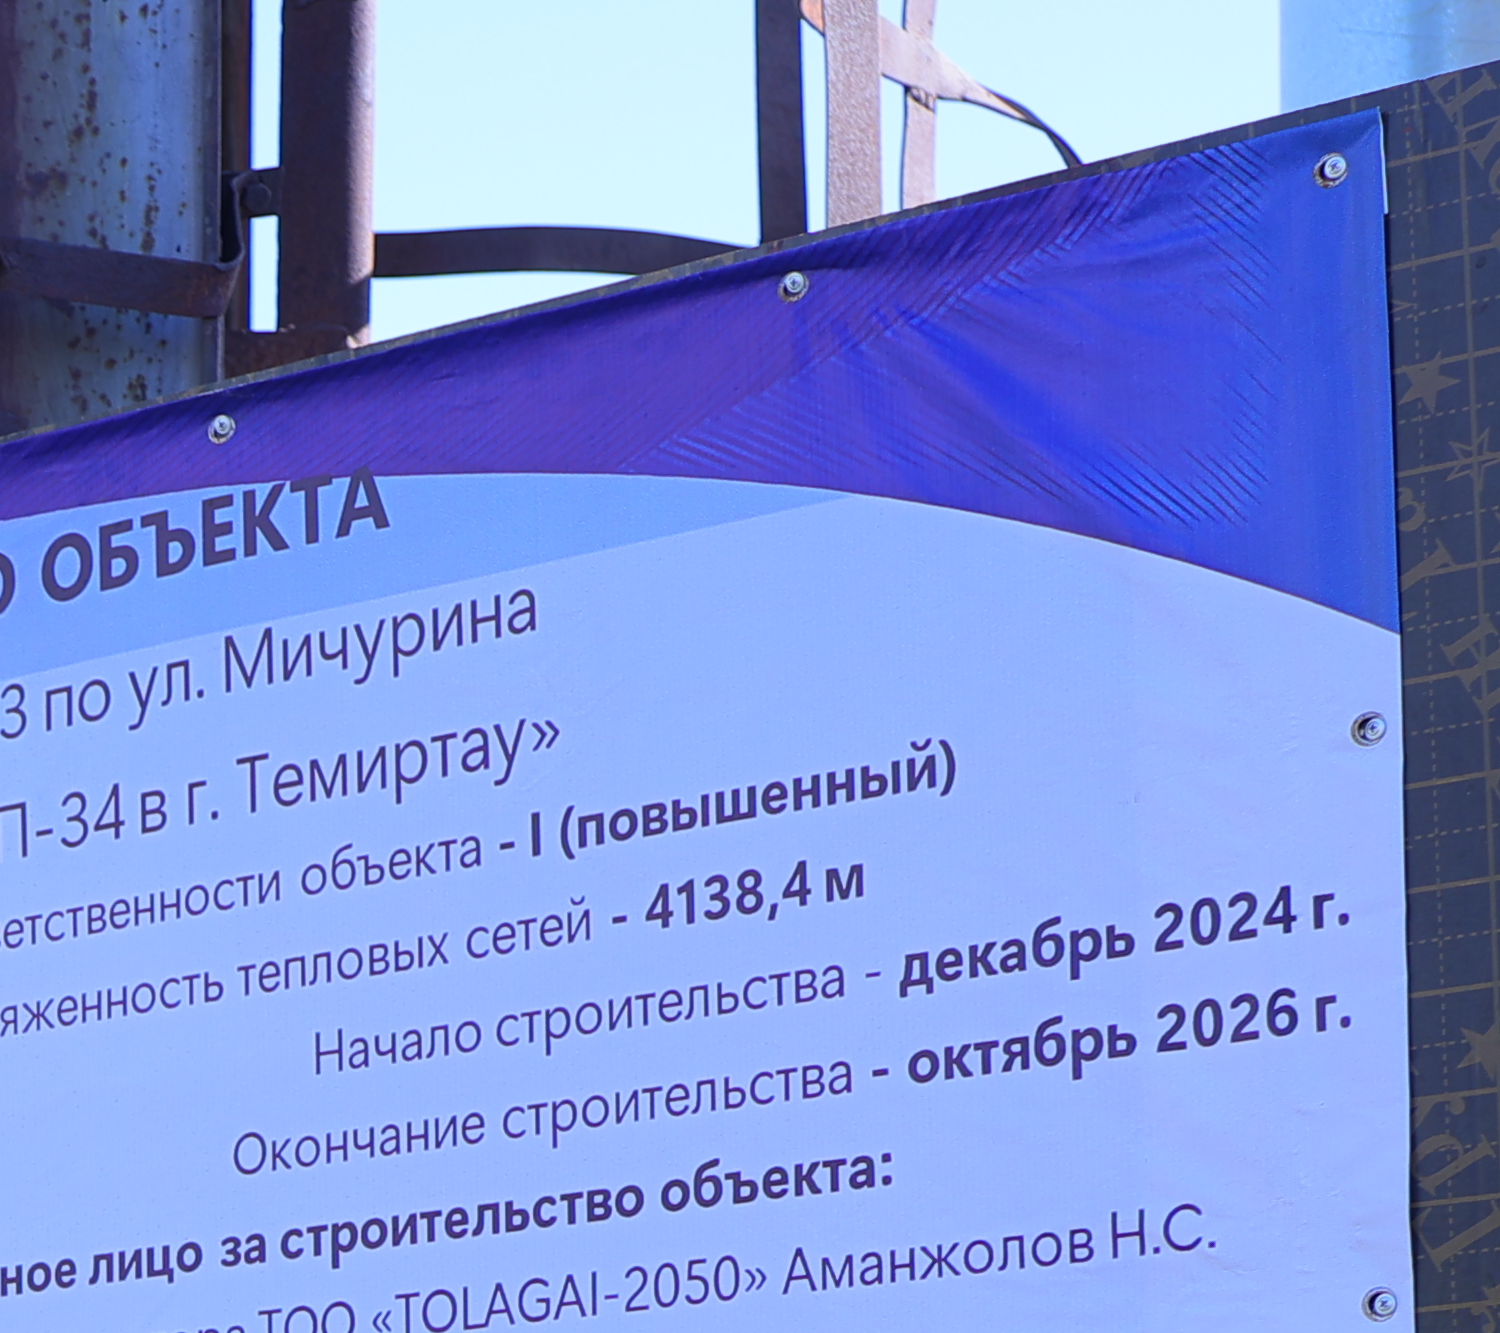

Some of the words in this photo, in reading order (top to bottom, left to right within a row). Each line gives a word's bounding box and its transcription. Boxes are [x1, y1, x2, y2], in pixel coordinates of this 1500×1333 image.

[41, 464, 392, 605] ОБЪЕКТА
[45, 679, 111, 731] по
[129, 659, 204, 731] ул.
[224, 588, 536, 693] Мичурина
[140, 790, 167, 834] в
[188, 780, 219, 825] г.
[236, 719, 560, 813] Темиртау»
[301, 836, 481, 895] объекта
[531, 811, 541, 857] I
[560, 738, 956, 860] (повышенный)
[237, 932, 448, 996] тепловых
[466, 895, 591, 959] сетей
[645, 860, 812, 928] 4138,4
[825, 864, 864, 902] м
[315, 1021, 482, 1075] Начало
[496, 965, 845, 1056] строительства
[899, 915, 1135, 998] декабрь
[1154, 885, 1298, 952] 2024
[1312, 893, 1350, 929] г.
[233, 1112, 485, 1175] Окончание
[503, 1060, 852, 1148] строительства
[908, 1015, 1137, 1084] октябрь
[1157, 987, 1299, 1053] 2026
[1315, 995, 1351, 1032] г.
[89, 1241, 203, 1285] лицо
[220, 1233, 267, 1267] за
[280, 1185, 645, 1269] строительство
[660, 1153, 892, 1212] объекта:
[783, 1228, 1094, 1295] Аманжолов
[1111, 1203, 1216, 1259] Н.С.
